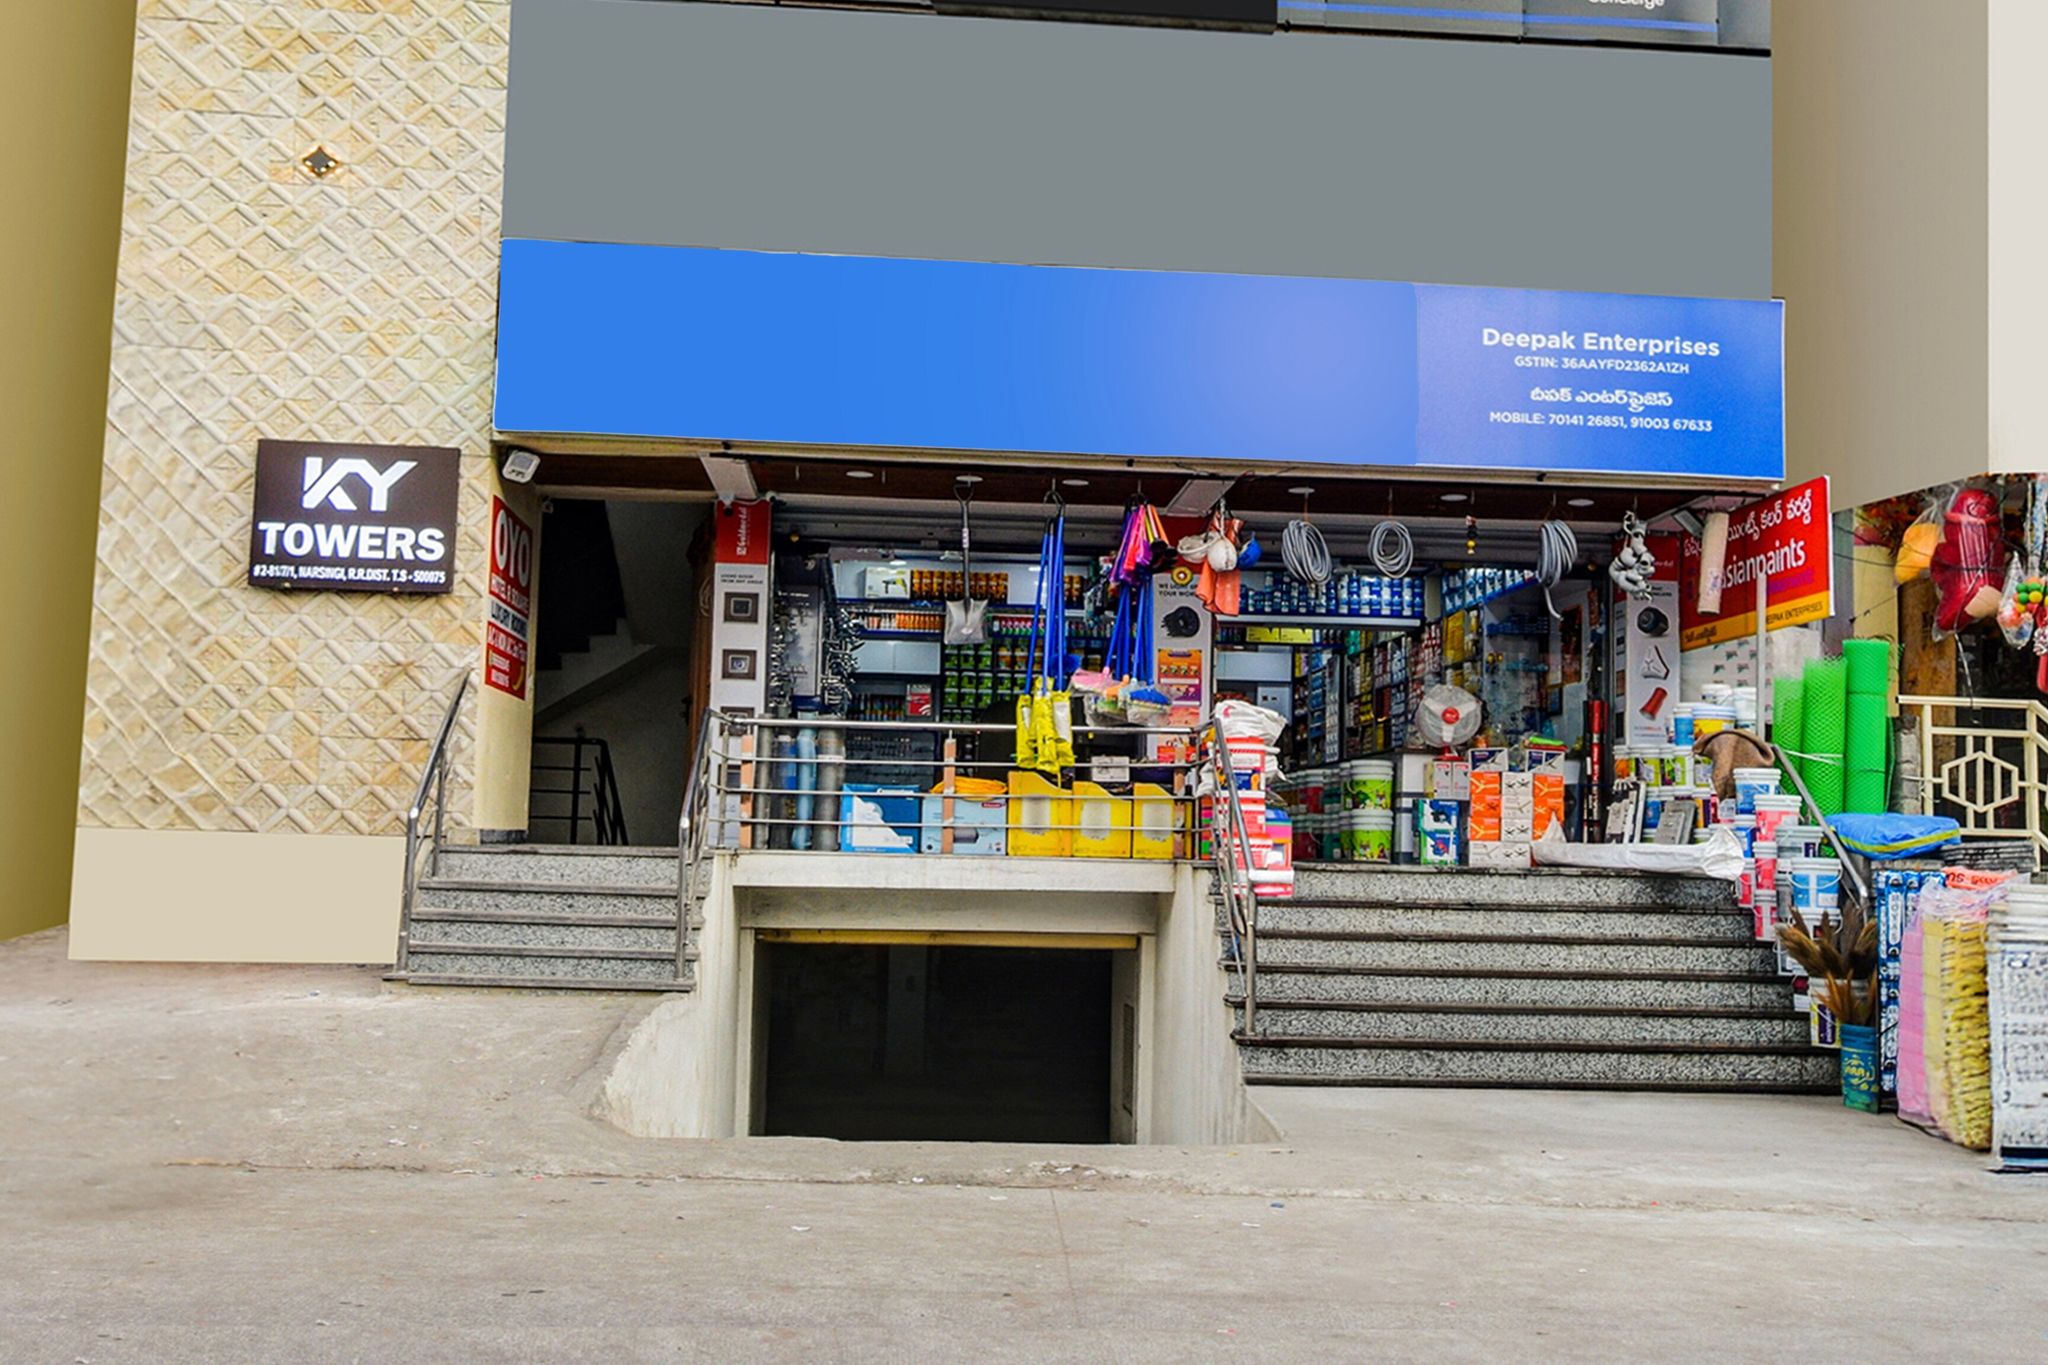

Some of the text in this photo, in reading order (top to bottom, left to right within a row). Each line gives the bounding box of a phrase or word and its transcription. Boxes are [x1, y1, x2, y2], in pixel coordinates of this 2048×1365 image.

[1482, 328, 1720, 357] Deepak Enterprises
[1515, 356, 1558, 369] GSTIN:
[1490, 411, 1713, 432] MOBILE: 70141 26851, 91003 67633
[258, 521, 446, 562] TOWERS
[495, 509, 530, 588] OYO
